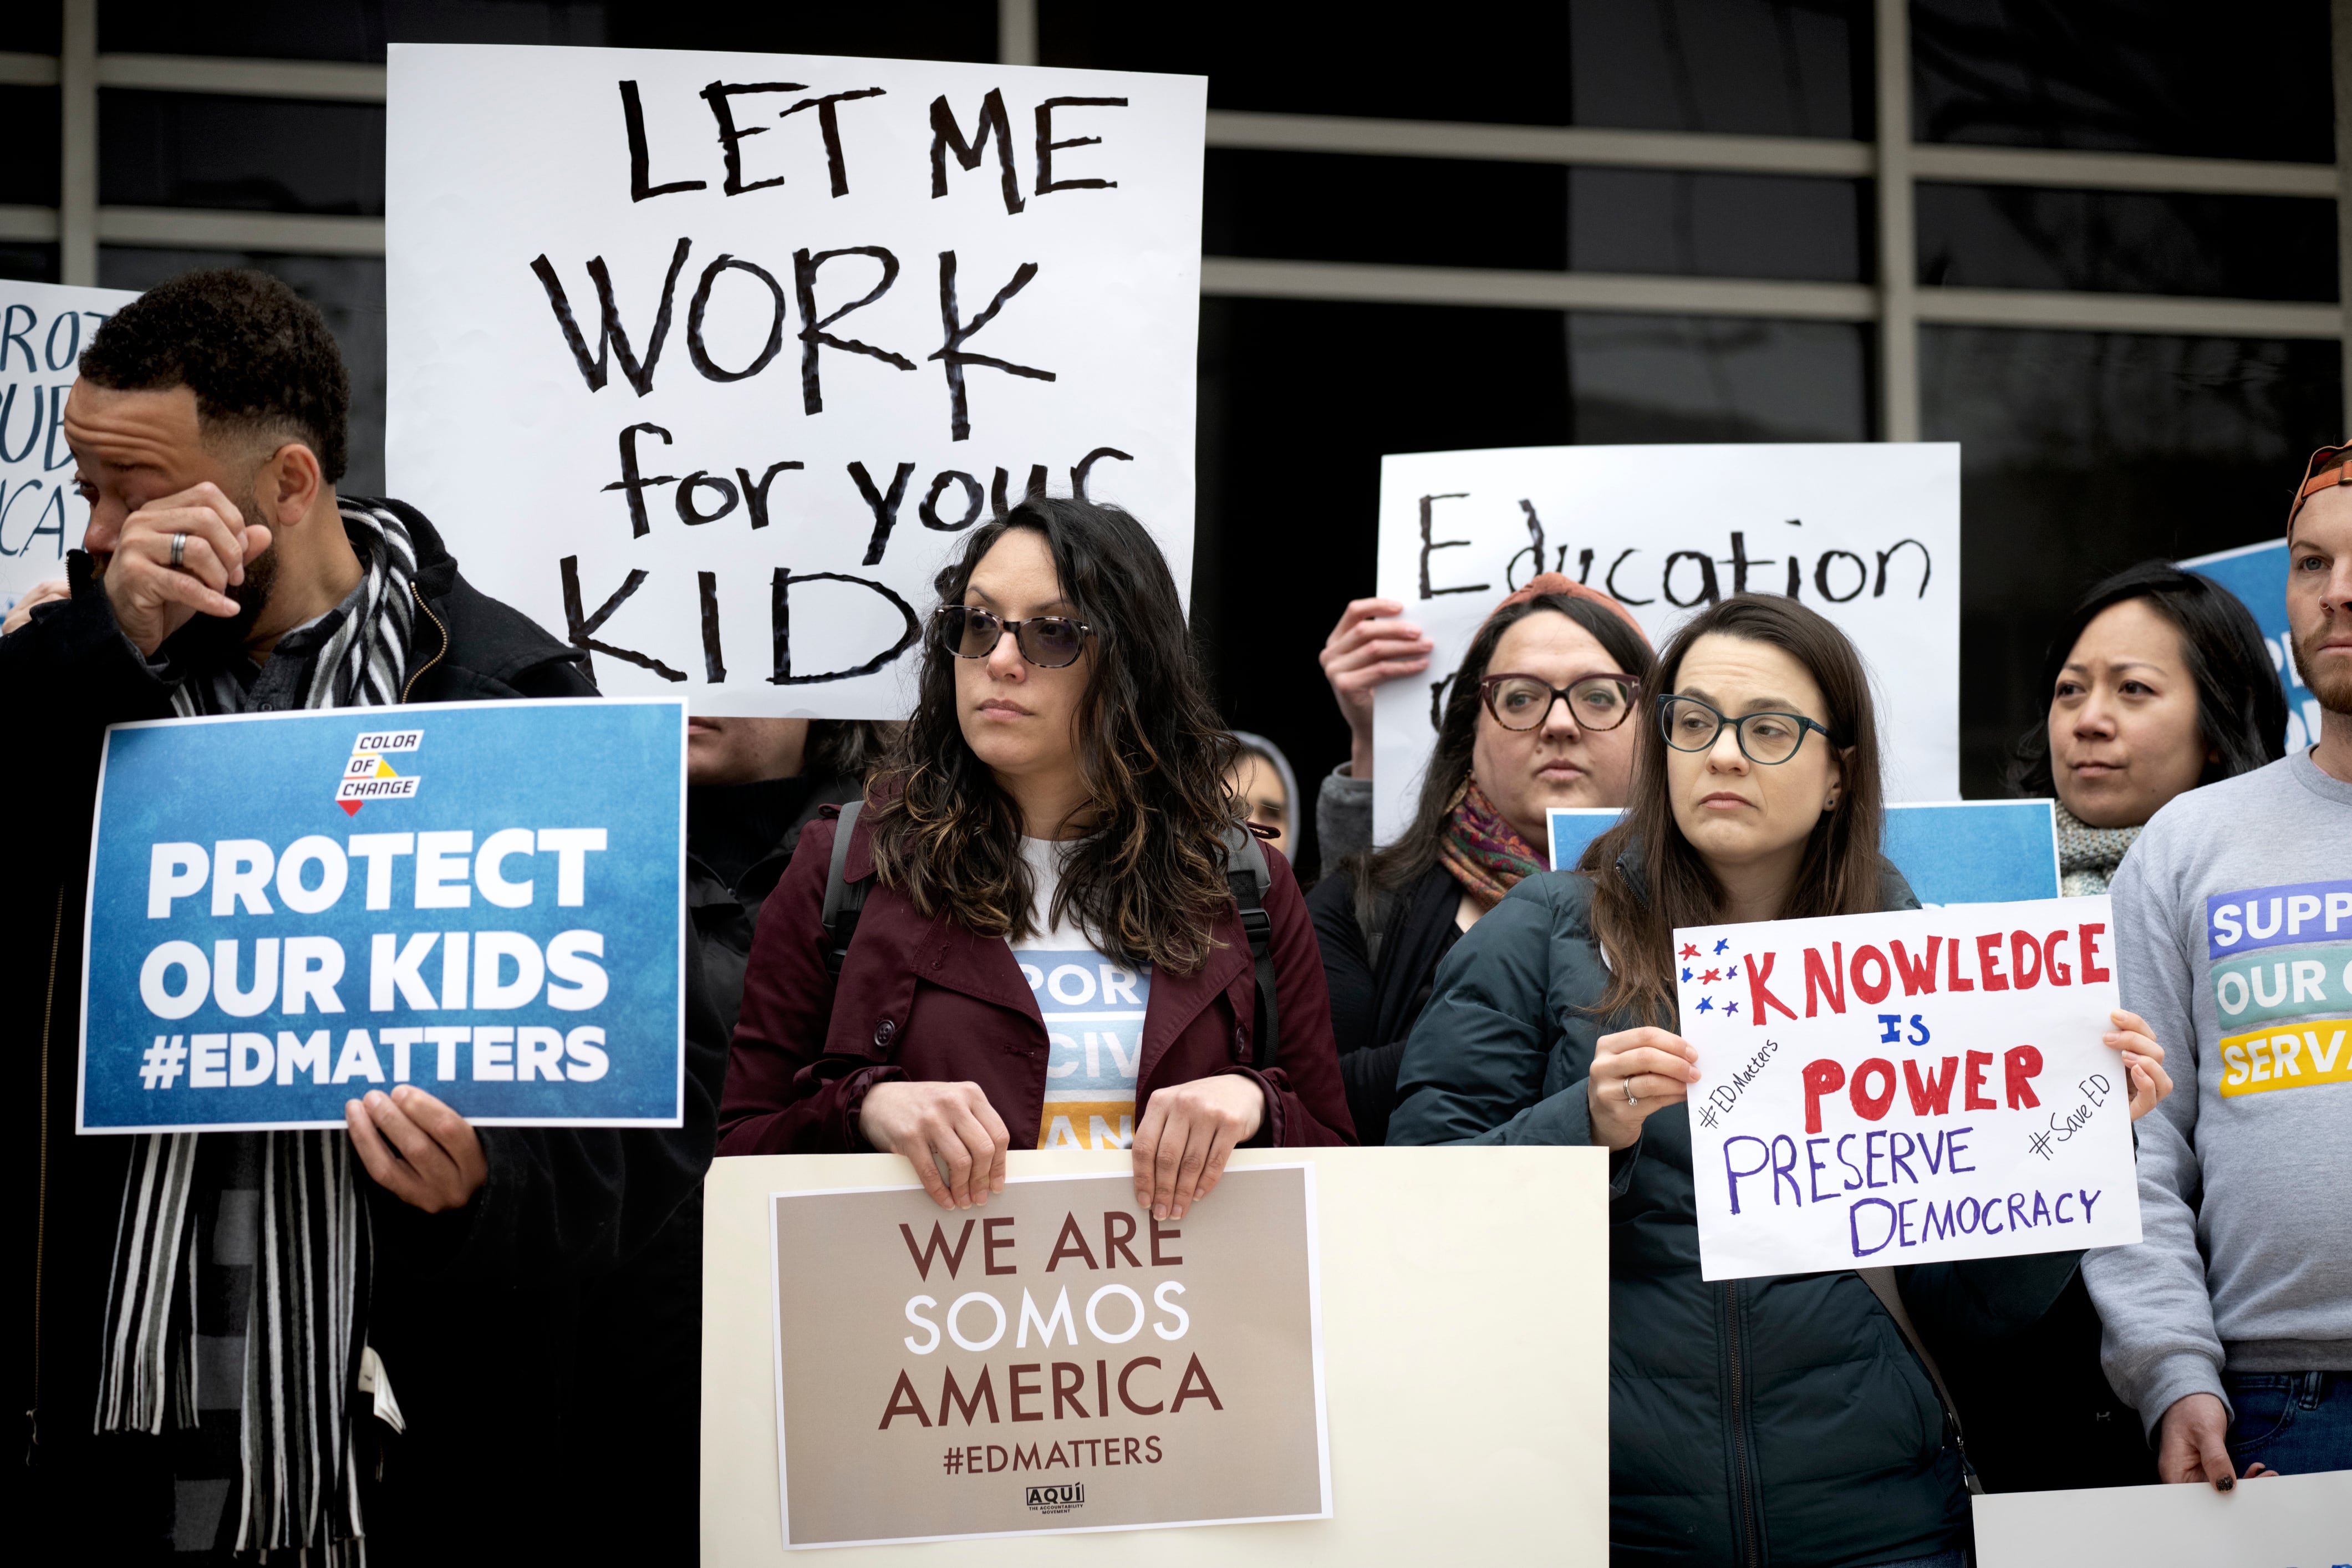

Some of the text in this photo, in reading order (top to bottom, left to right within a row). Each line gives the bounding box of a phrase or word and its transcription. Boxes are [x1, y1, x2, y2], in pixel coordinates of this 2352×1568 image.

[618, 80, 1128, 215] LET ME
[530, 237, 1057, 441] WORK
[600, 422, 1134, 566] for your
[1419, 492, 1932, 610] Education
[559, 554, 958, 688] KID
[350, 759, 375, 773] OF
[359, 735, 418, 750] COLOR
[342, 780, 414, 796] CHANGE
[147, 827, 608, 919] PROTECT
[2213, 892, 2352, 947] SUPP
[139, 929, 609, 1020] OUR KIDS
[1019, 964, 1152, 1006] POR
[1743, 923, 2110, 1026] KNOWLEDGE
[2218, 959, 2327, 1016] OUR
[139, 1025, 610, 1090] #EDMATTERS
[1877, 1014, 1931, 1046] IS
[2223, 1030, 2352, 1086] SERV
[1801, 1045, 2044, 1135] POWER
[1723, 1127, 1977, 1215] PRESERVE
[899, 1207, 1183, 1283] WE ARE
[1849, 1189, 2102, 1258] DEMOCRACY
[903, 1280, 1190, 1355] SOMOS
[878, 1352, 1224, 1430] AMERICA
[943, 1435, 1163, 1475] #EDMATTERS
[1029, 1482, 1081, 1504] AQUÍ
